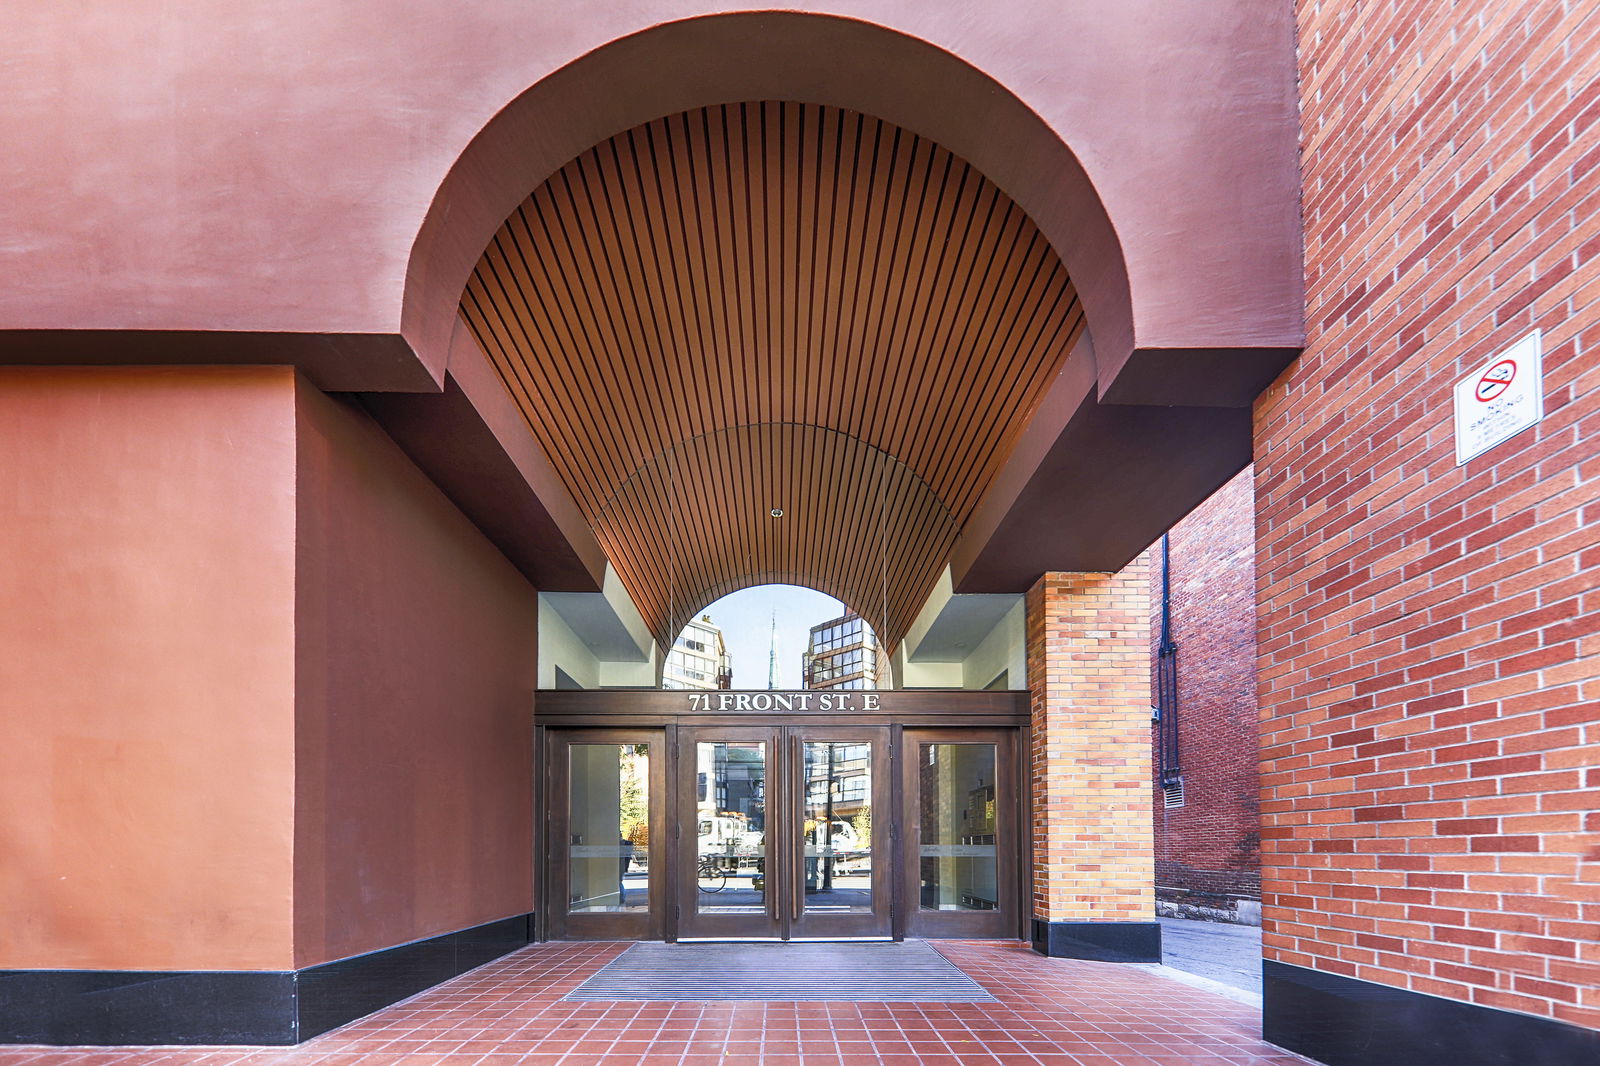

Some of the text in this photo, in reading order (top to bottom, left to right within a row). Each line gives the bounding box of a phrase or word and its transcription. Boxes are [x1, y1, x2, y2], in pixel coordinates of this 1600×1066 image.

[1470, 393, 1524, 431] SMOKING
[688, 693, 880, 712] 71 FRONT ST. E
